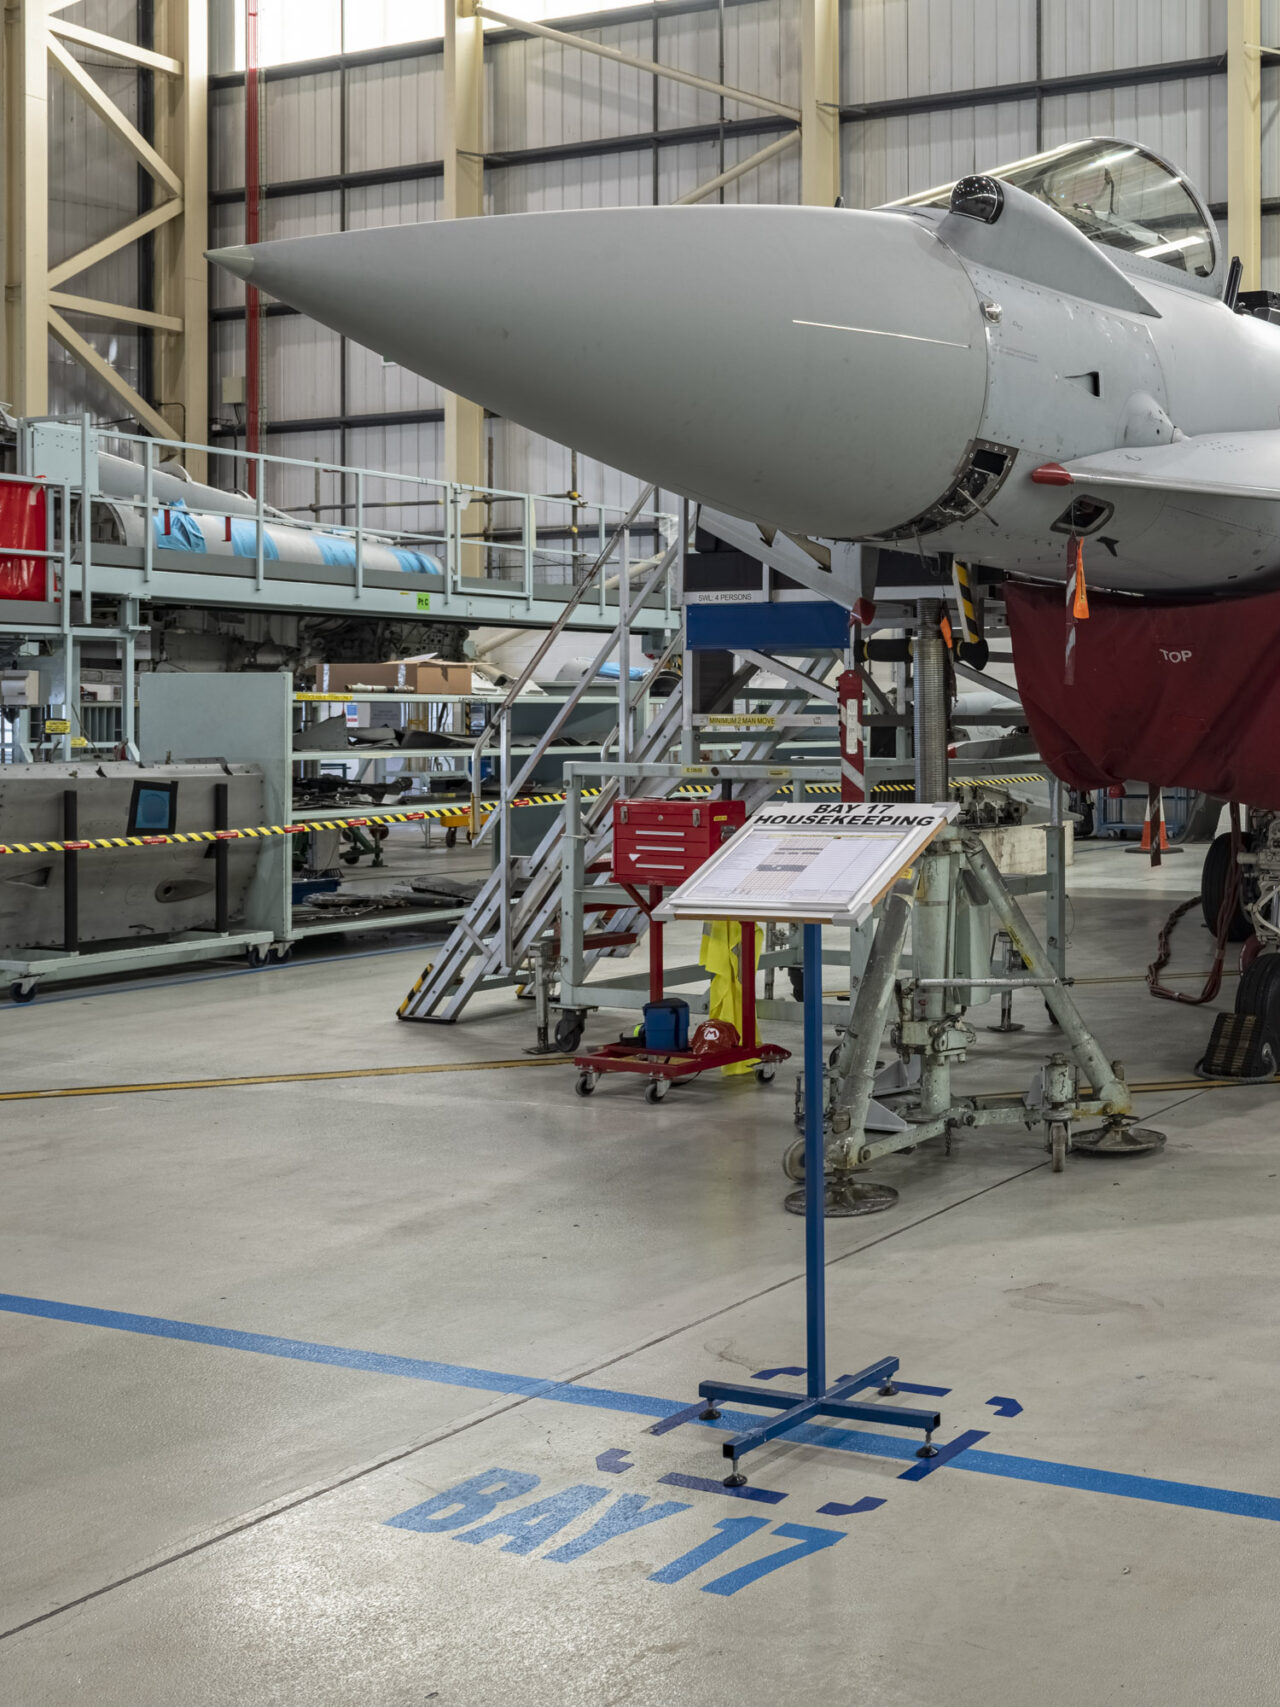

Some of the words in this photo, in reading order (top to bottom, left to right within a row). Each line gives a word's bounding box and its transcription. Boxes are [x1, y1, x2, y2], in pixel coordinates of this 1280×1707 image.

[720, 593, 752, 601] PERSONS
[1159, 648, 1192, 663] TOP
[709, 716, 737, 725] MINIMUM
[742, 716, 756, 725] MAN
[756, 716, 775, 725] MOVE
[813, 804, 860, 814] BAY
[866, 804, 895, 814] 17
[753, 815, 936, 826] HOUSEKEEPING
[381, 1466, 694, 1564] BAY
[646, 1515, 849, 1597] 17
